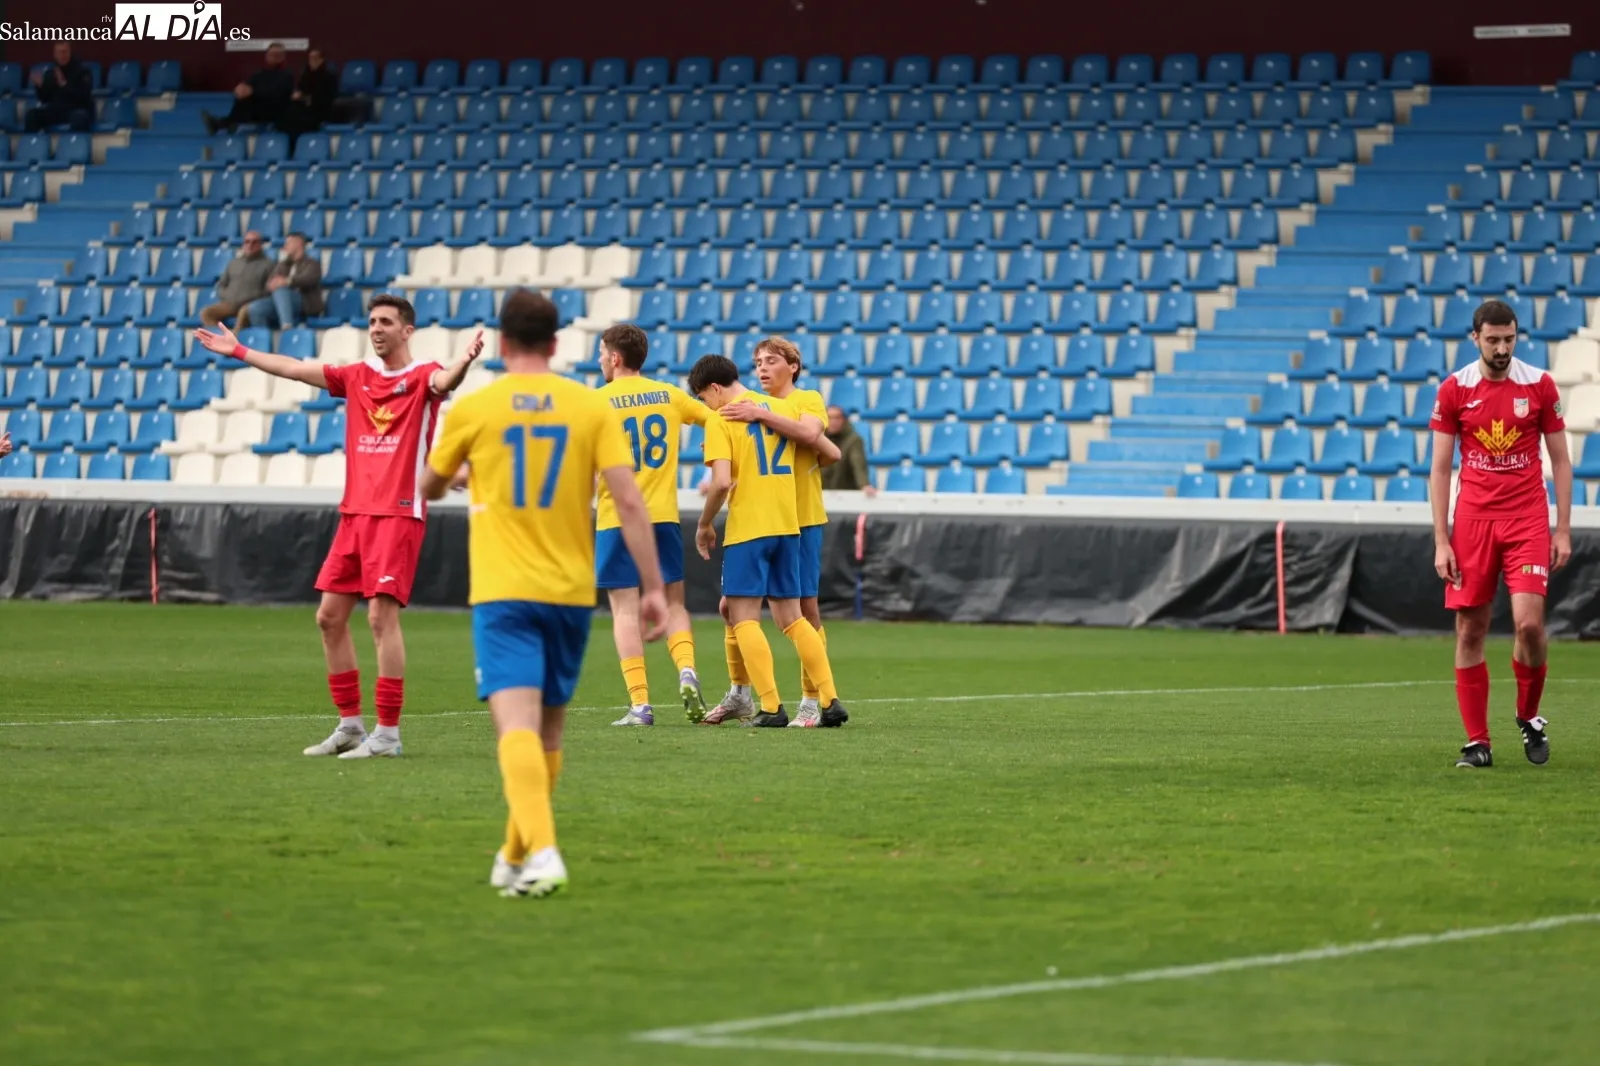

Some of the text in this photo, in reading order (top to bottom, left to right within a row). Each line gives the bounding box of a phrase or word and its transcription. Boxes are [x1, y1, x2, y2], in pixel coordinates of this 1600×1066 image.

[503, 424, 569, 509] 17
[623, 413, 668, 472] 18
[747, 419, 792, 476] 12
